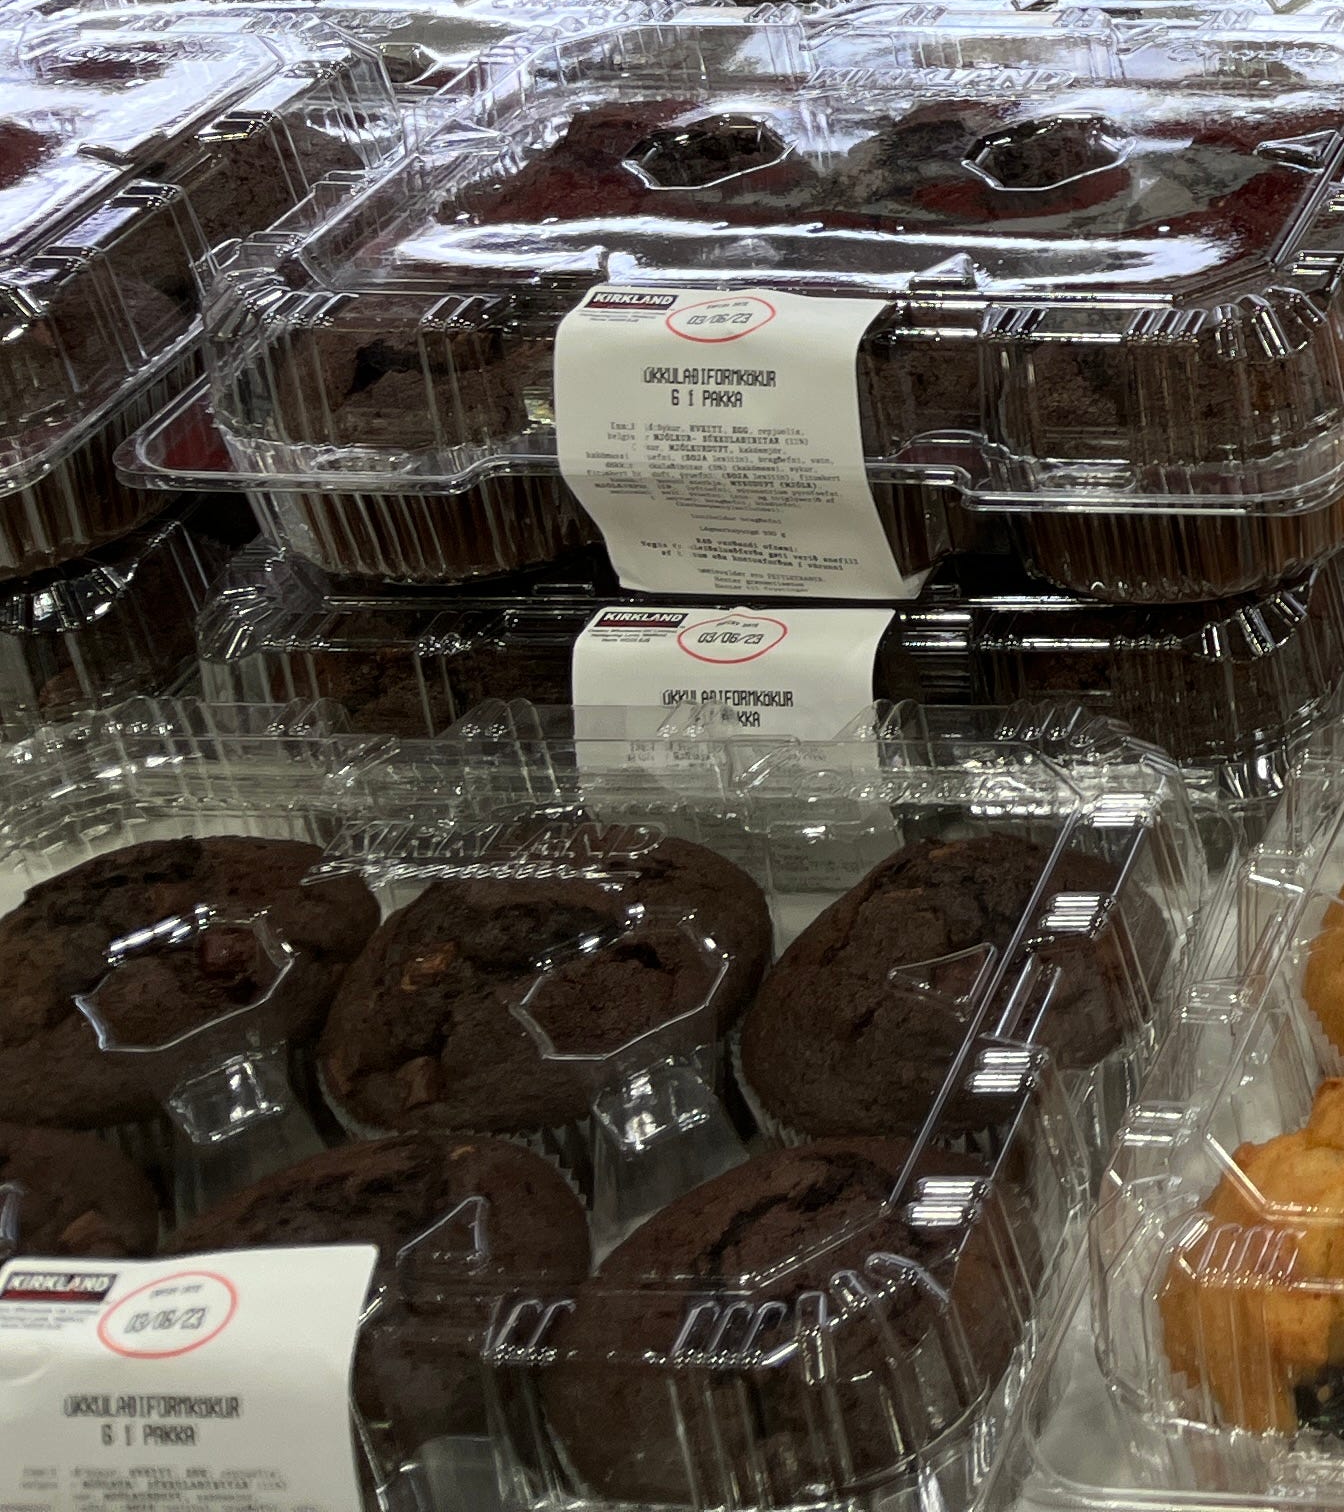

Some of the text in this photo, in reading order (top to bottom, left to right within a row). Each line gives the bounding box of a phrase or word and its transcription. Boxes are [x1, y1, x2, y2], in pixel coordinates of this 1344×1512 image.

[592, 293, 675, 306] KIRKLAND
[670, 389, 680, 406] 6
[702, 390, 743, 408] PAKKA
[603, 611, 684, 623] KIRKLAND
[697, 631, 765, 645] 03/06/23
[9, 1274, 110, 1292] KIRKLAND
[143, 1424, 197, 1447] PAKKA
